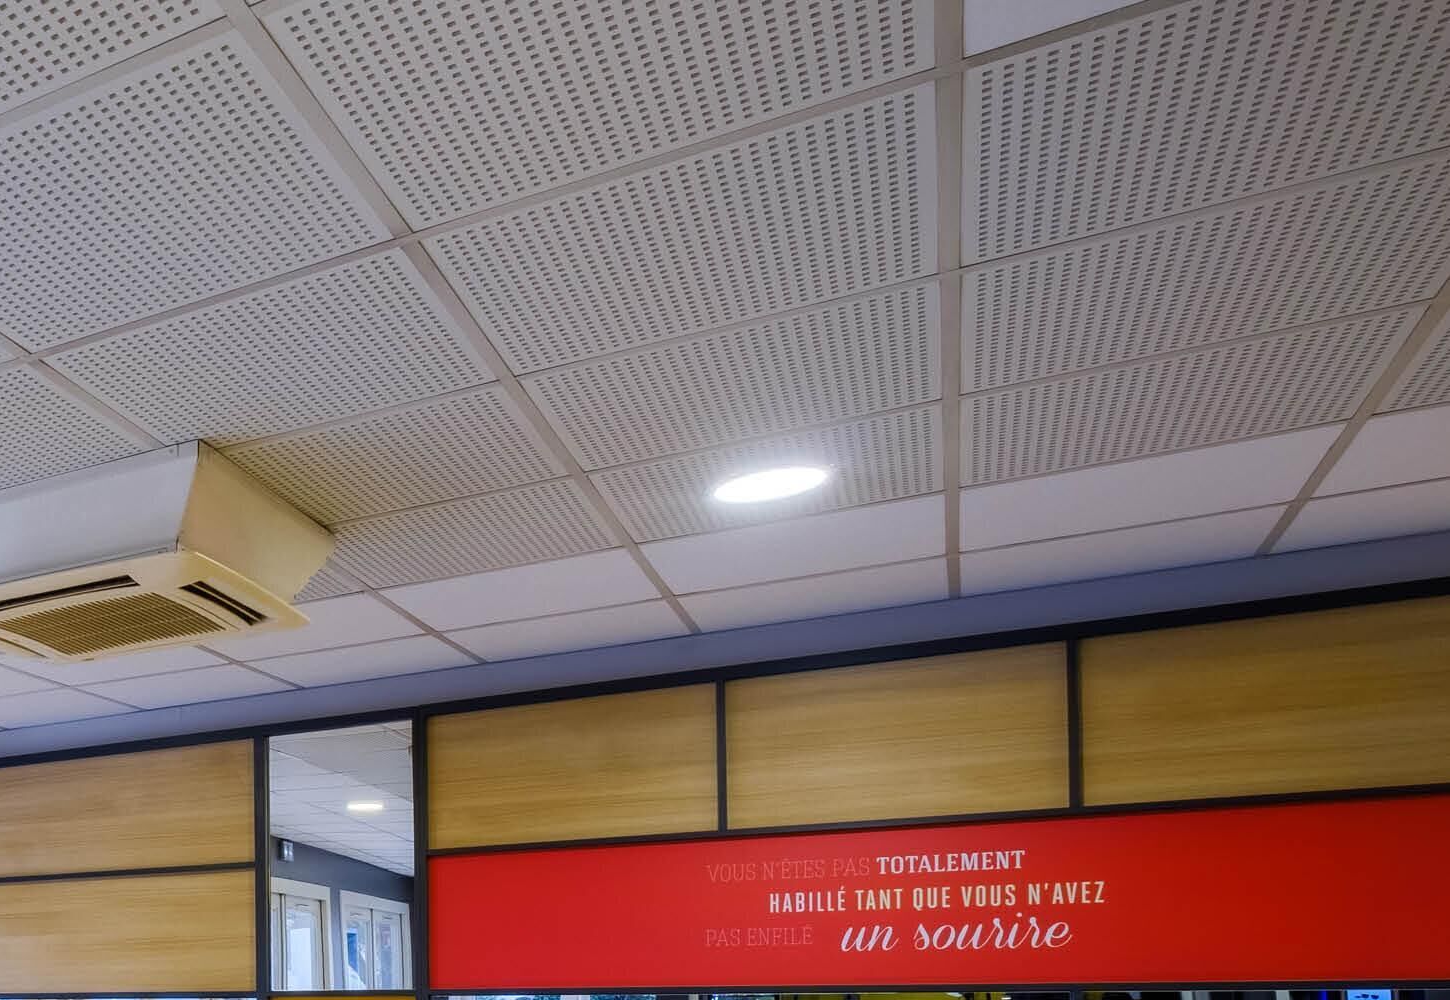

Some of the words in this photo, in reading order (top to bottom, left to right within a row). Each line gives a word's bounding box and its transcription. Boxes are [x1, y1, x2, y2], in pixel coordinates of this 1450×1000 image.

[707, 863, 757, 883] VOUS
[831, 857, 870, 877] PAS
[877, 849, 1026, 875] TOTALEMENT
[769, 885, 846, 913] HABILLÉ
[855, 888, 903, 911] TANT
[912, 886, 951, 911] QUE
[961, 883, 1016, 907] VOUS
[1027, 880, 1106, 906] N'AVEZ
[705, 927, 741, 947] PAS
[747, 923, 813, 947] ENFILÉ
[839, 923, 900, 952] un
[913, 912, 1074, 951] sourire
